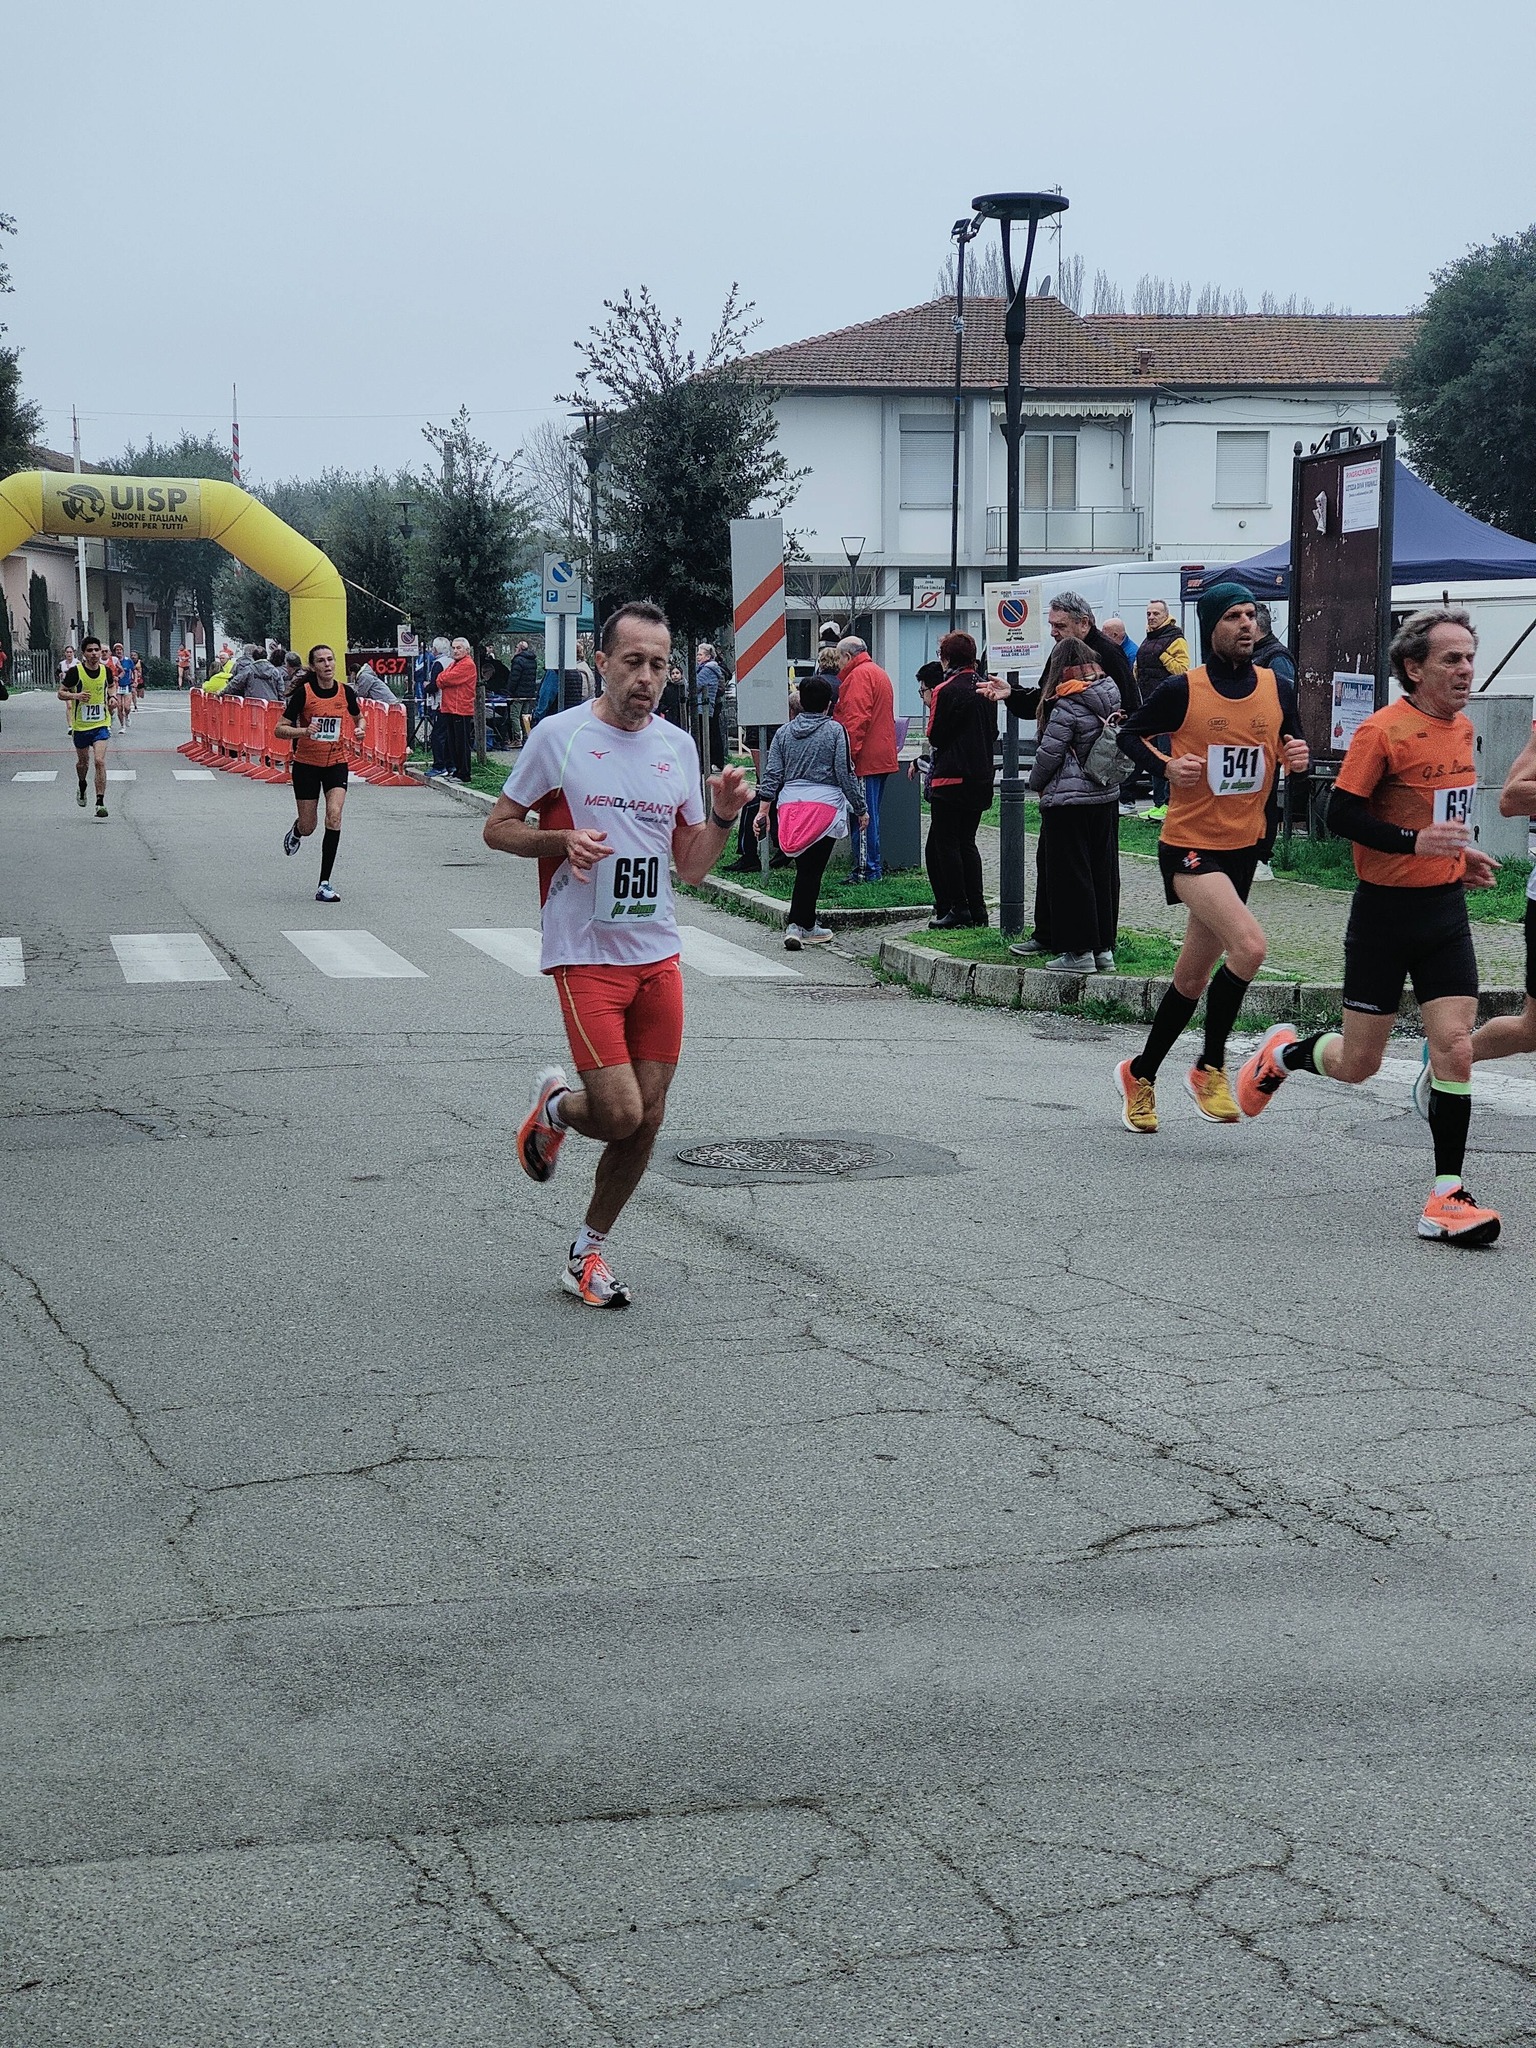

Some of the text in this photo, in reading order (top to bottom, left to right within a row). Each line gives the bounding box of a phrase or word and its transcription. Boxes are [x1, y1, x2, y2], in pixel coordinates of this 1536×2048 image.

[110, 485, 188, 512] UISP
[111, 512, 188, 522] UNIONE ITALIANA
[111, 521, 139, 529] SPORT
[142, 522, 157, 530] PER
[86, 704, 100, 716] 720
[1222, 747, 1259, 778] 541
[613, 856, 659, 899] 650
